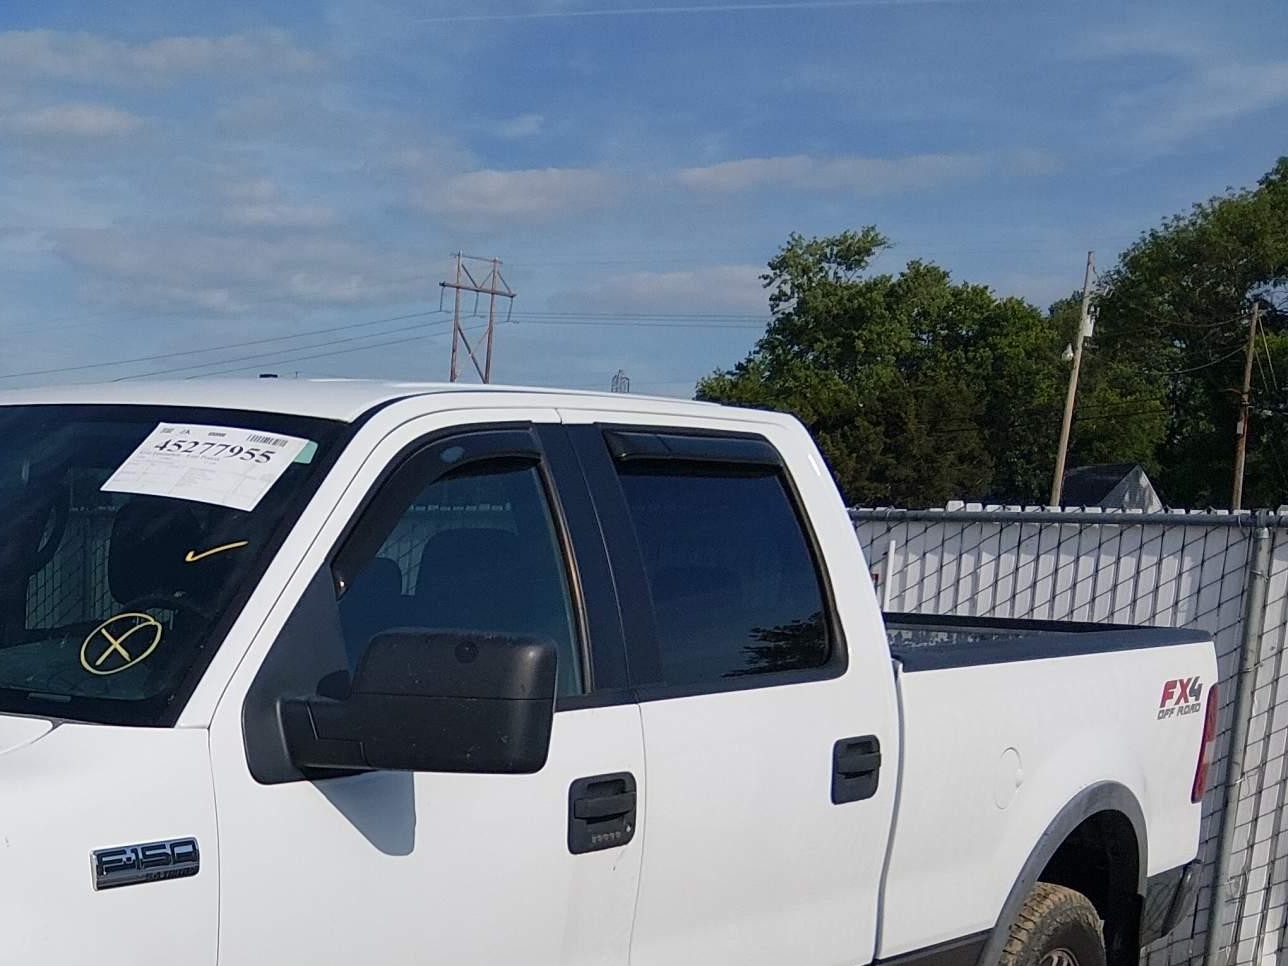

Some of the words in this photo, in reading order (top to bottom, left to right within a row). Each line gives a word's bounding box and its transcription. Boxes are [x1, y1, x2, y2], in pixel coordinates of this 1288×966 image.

[155, 440, 276, 464] 45277955
[1159, 676, 1203, 708] FX4
[1157, 707, 1176, 720] OFF
[1176, 703, 1201, 716] ROAD
